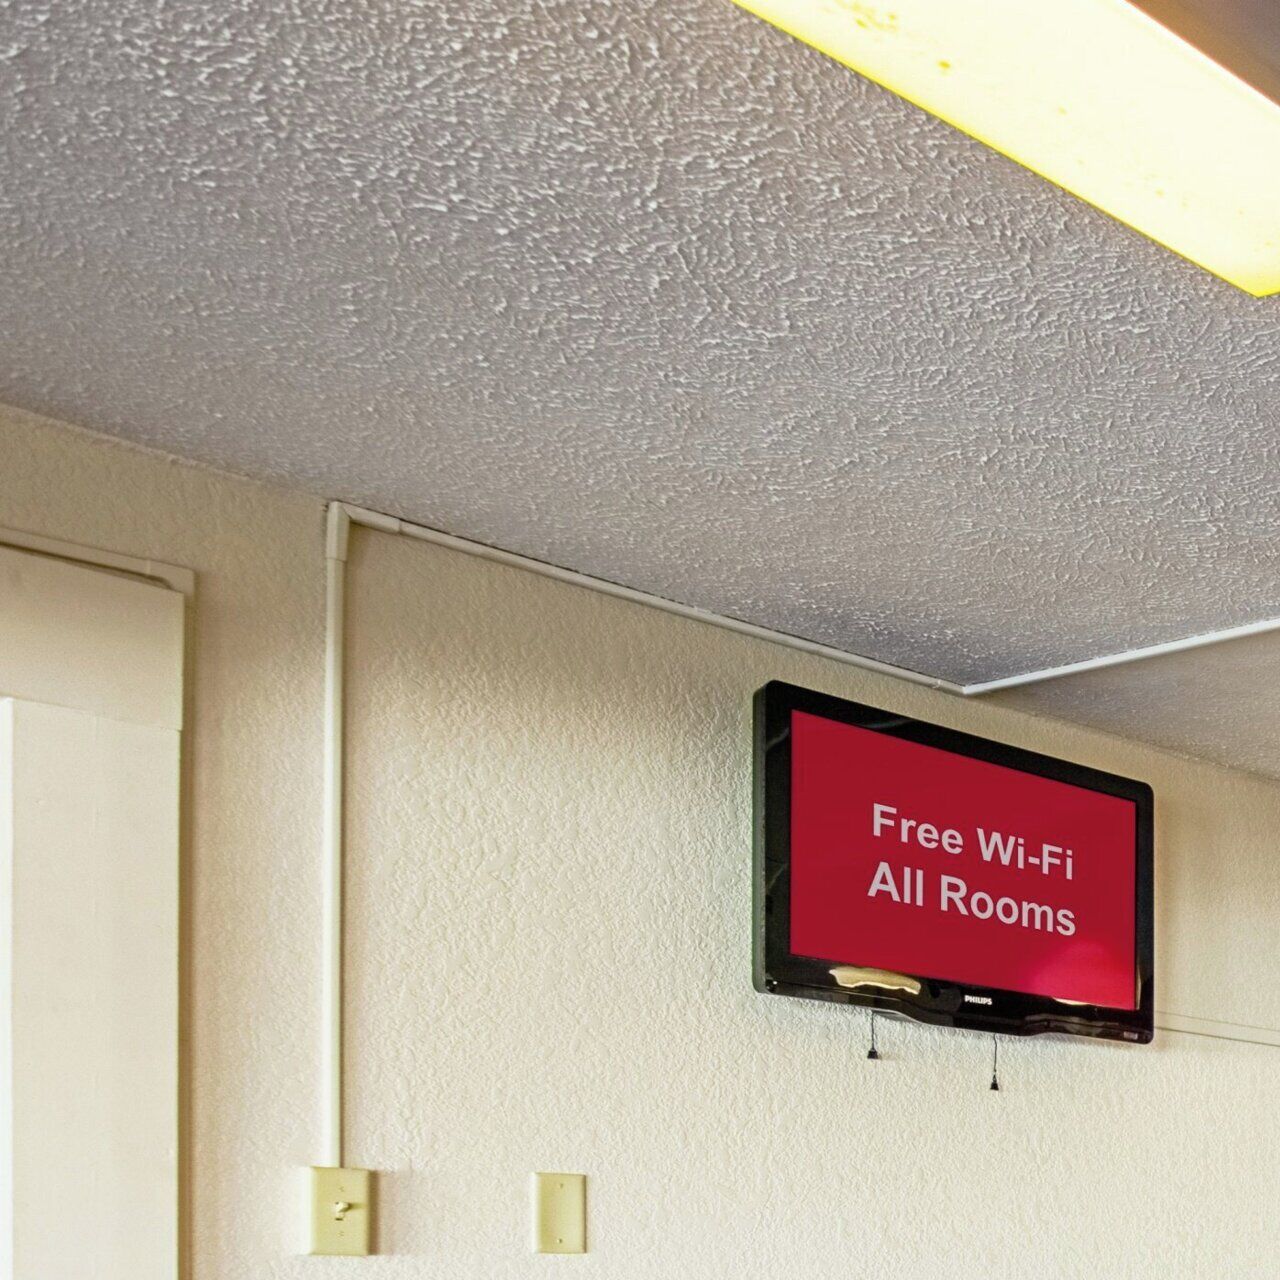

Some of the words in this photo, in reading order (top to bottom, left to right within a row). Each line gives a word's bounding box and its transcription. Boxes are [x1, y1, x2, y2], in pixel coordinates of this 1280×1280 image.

[873, 803, 964, 855] Free
[976, 828, 1073, 880] Wi-Fi
[867, 861, 923, 907] All
[940, 875, 1076, 936] Rooms
[964, 994, 992, 1006] PHILIPS
